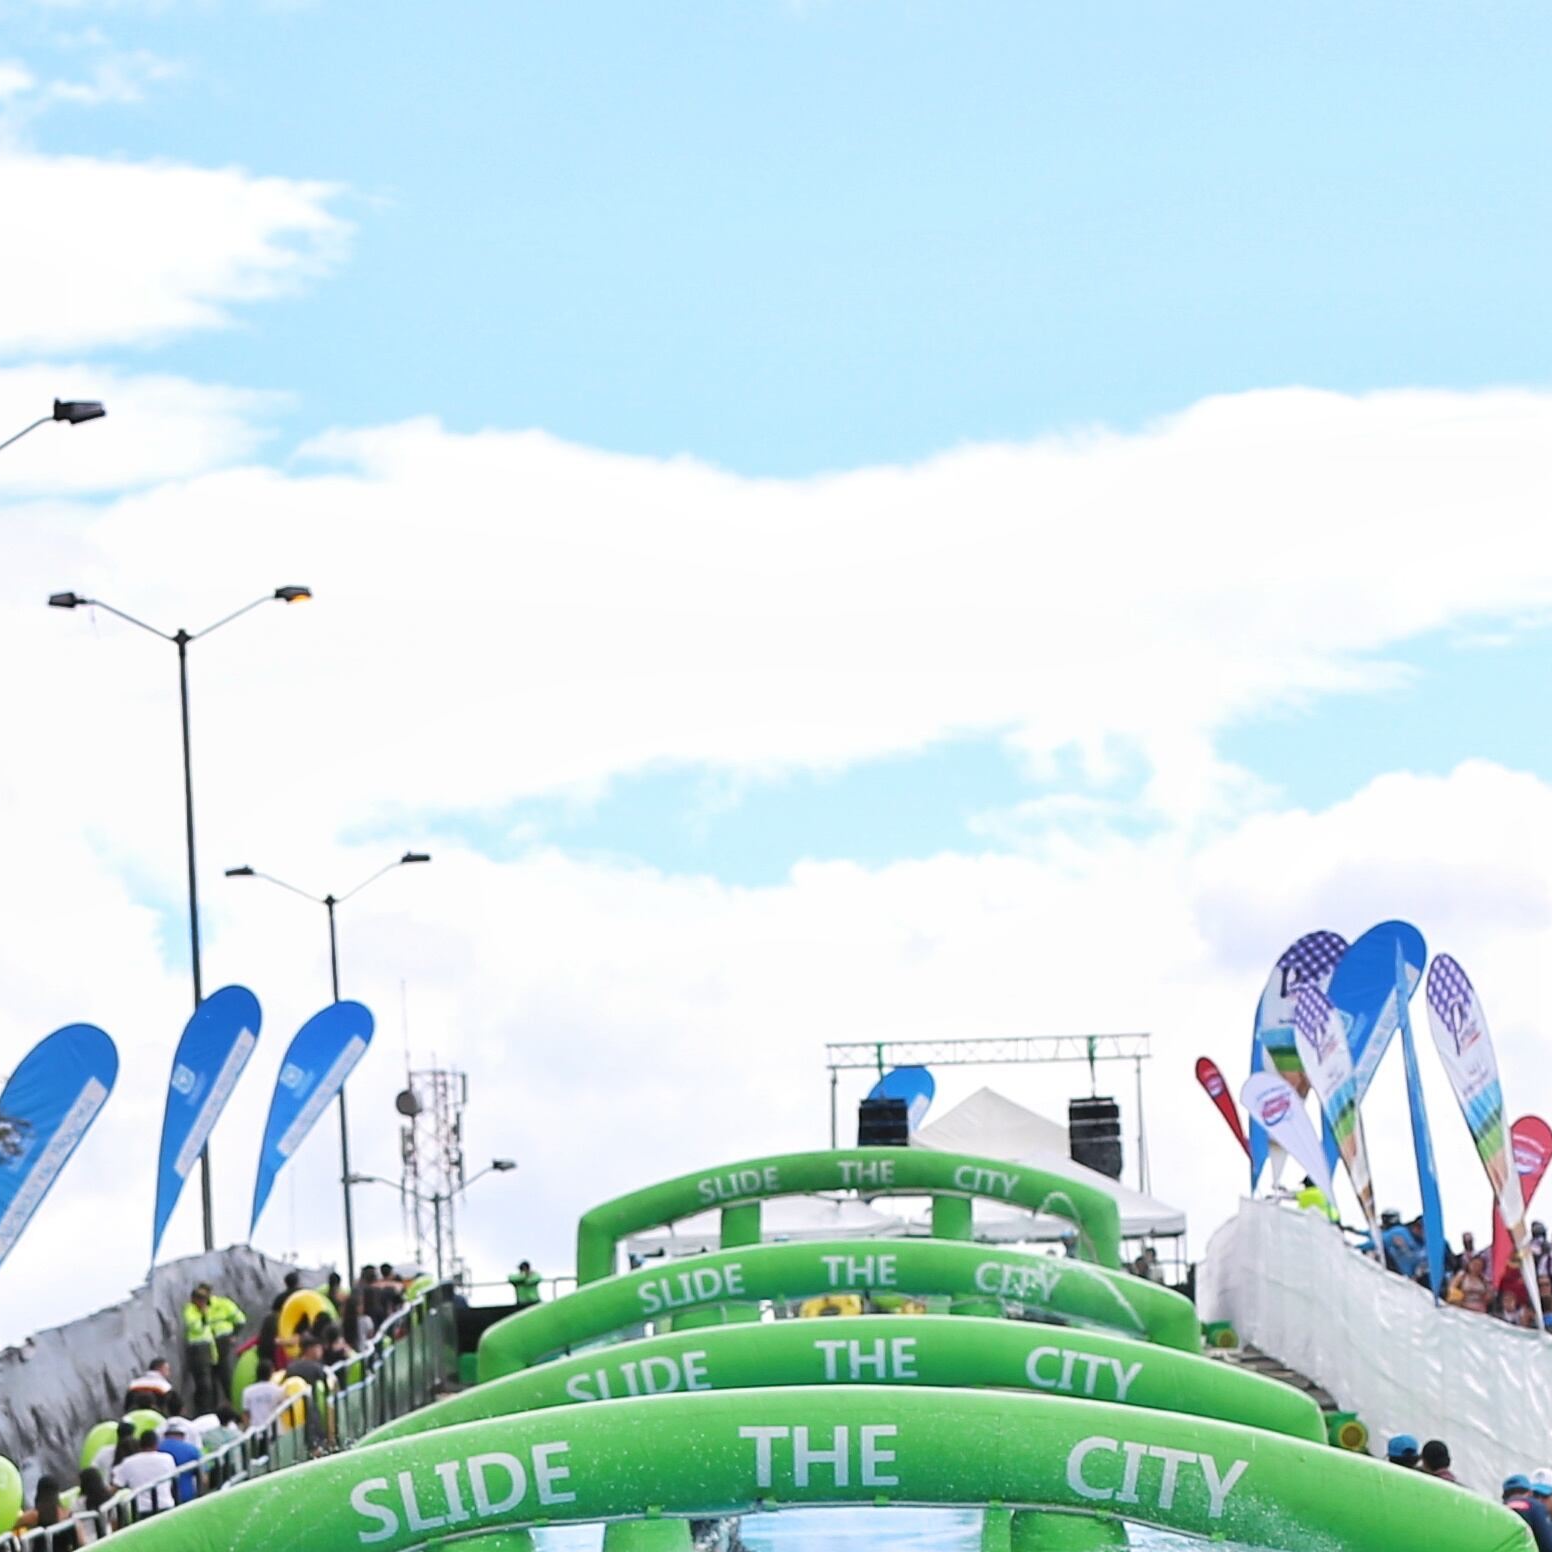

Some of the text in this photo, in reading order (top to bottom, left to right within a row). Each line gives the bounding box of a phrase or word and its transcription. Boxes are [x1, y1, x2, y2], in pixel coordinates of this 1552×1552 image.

[698, 1160, 1019, 1202] SLIDE THE CITY
[637, 1255, 1062, 1315] SLIDE THE CITY
[566, 1338, 1143, 1401] SLIDE THE CITY
[350, 1425, 1248, 1543] SLIDE THE CITY
